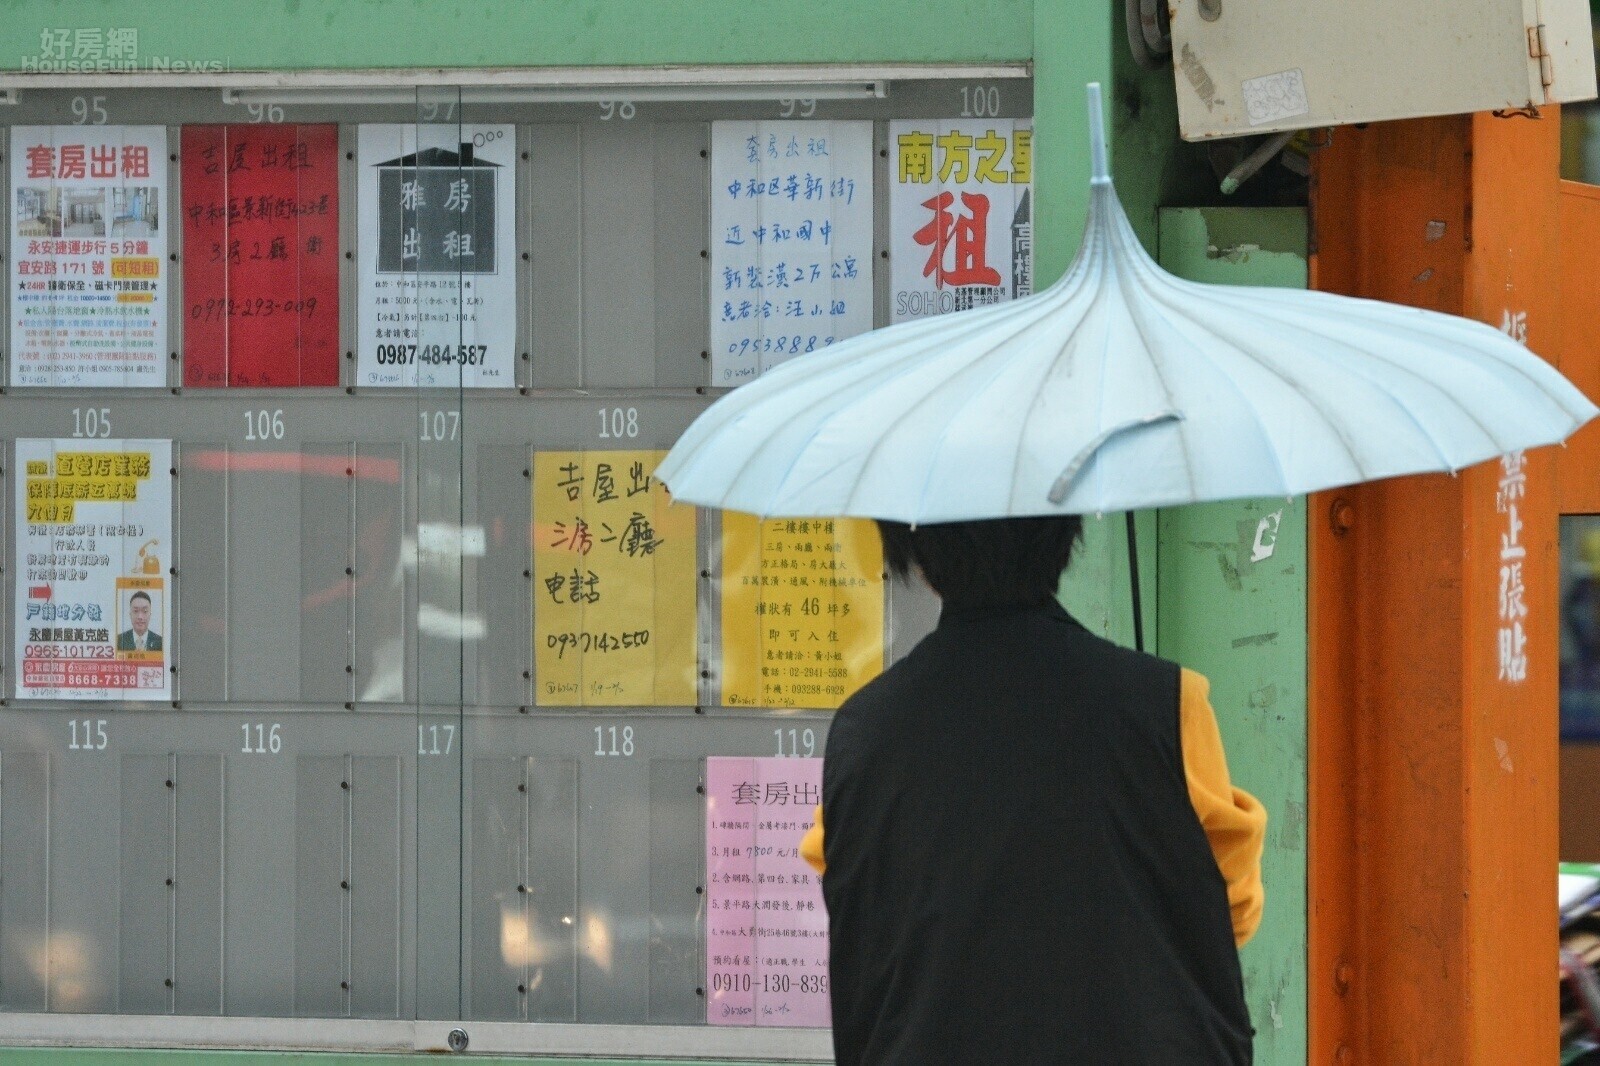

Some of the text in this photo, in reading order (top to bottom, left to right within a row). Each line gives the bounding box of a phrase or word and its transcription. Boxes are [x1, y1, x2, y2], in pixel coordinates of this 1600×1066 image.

[71, 96, 108, 125] 95
[960, 86, 999, 117] 100
[26, 144, 149, 178] 套房出租
[202, 142, 314, 176] 吉屋出租
[898, 130, 1031, 184] 南方之星
[400, 178, 471, 213] 雅房
[402, 227, 475, 261] 出租
[725, 220, 832, 245] 近中和國中
[912, 190, 1002, 290] 租
[111, 243, 119, 254] 5
[62, 262, 86, 275] 171
[92, 260, 104, 275] 號
[897, 291, 954, 316] SOHO
[377, 344, 488, 366] 0987-484-587
[72, 409, 111, 438] 105
[244, 411, 284, 440] 106
[420, 411, 459, 440] 107
[598, 407, 639, 438] 108
[557, 461, 670, 504] 吉屋出
[551, 512, 664, 557] 三房二廳
[801, 597, 820, 616] 46
[547, 630, 650, 660] 0937142550
[68, 674, 137, 685] 8668-7338
[68, 720, 108, 750] 115
[240, 723, 281, 753] 116
[418, 725, 455, 755] 117
[594, 726, 634, 756] 118
[774, 728, 815, 758] 119
[731, 781, 820, 806] 套房出
[713, 972, 827, 994] 0910-130-839
